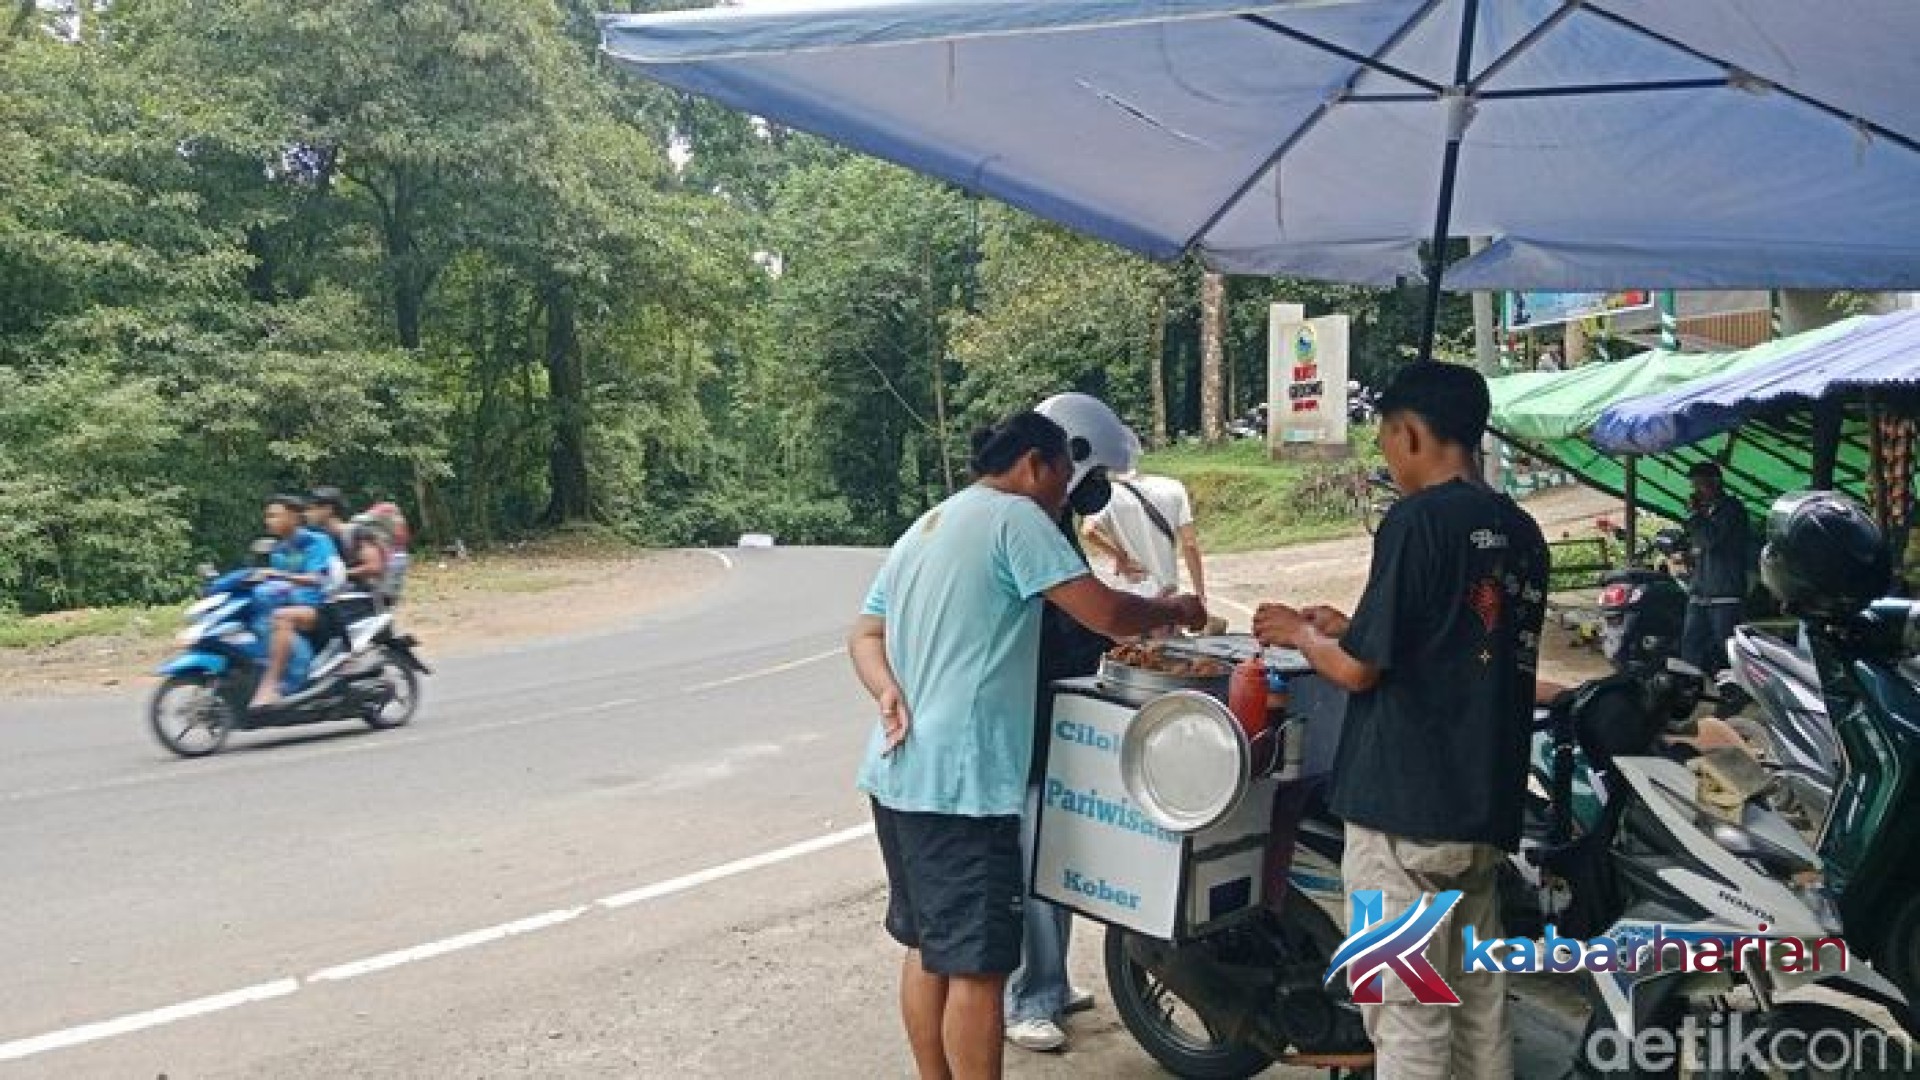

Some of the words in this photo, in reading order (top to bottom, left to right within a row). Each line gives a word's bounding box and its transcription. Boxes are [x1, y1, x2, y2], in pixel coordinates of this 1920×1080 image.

[1055, 719, 1121, 752] Cilo
[1063, 867, 1142, 910] Kober
[1719, 890, 1776, 925] HONDA
